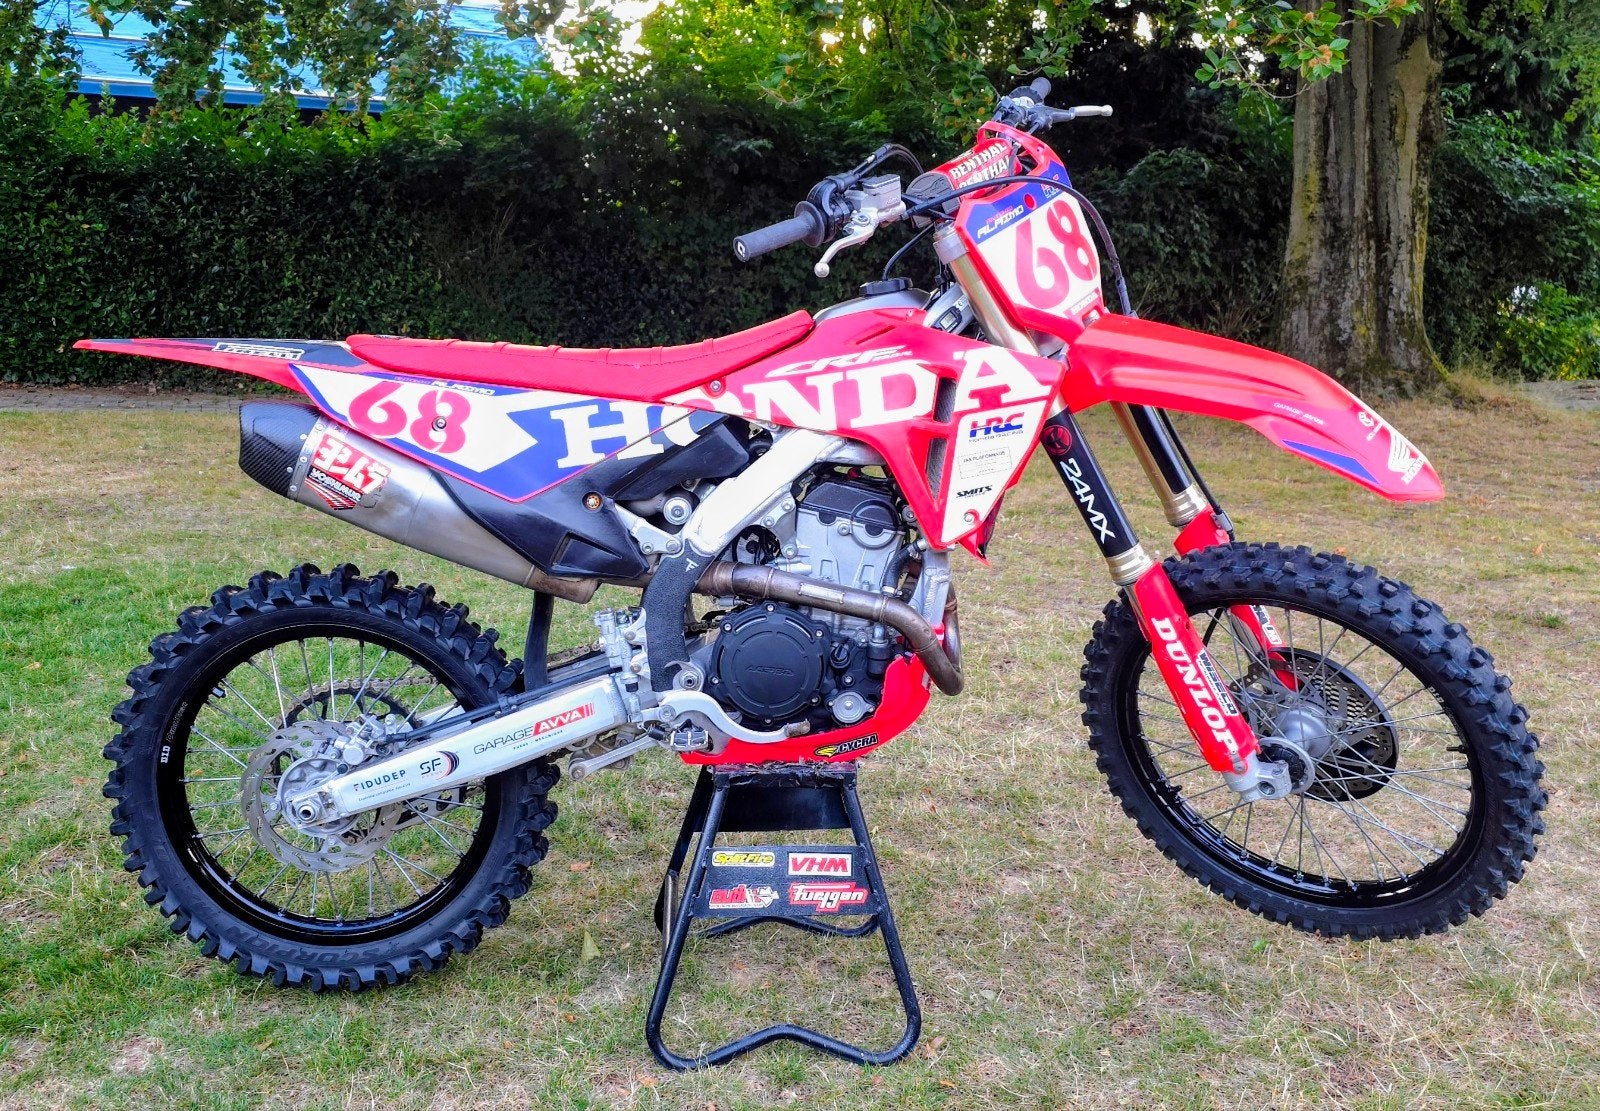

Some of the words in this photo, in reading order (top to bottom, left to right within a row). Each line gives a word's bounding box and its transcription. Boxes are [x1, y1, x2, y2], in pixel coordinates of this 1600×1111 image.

[950, 142, 1008, 180] RENTHAL
[1015, 199, 1099, 310] 68
[348, 380, 471, 454] 68
[551, 345, 1051, 469] HONDA
[969, 412, 1025, 438] HRC
[956, 485, 993, 498] SMITS
[1059, 457, 1116, 545] 24MX
[1151, 617, 1239, 754] DUNLOP
[1198, 650, 1238, 715] WISECO
[473, 725, 534, 755] GARAGE
[538, 709, 583, 733] AVVA
[836, 733, 877, 754] CYCRA
[160, 745, 171, 764] DID
[419, 757, 442, 776] SF
[353, 769, 407, 792] FIDUDEP
[790, 857, 849, 873] VHM
